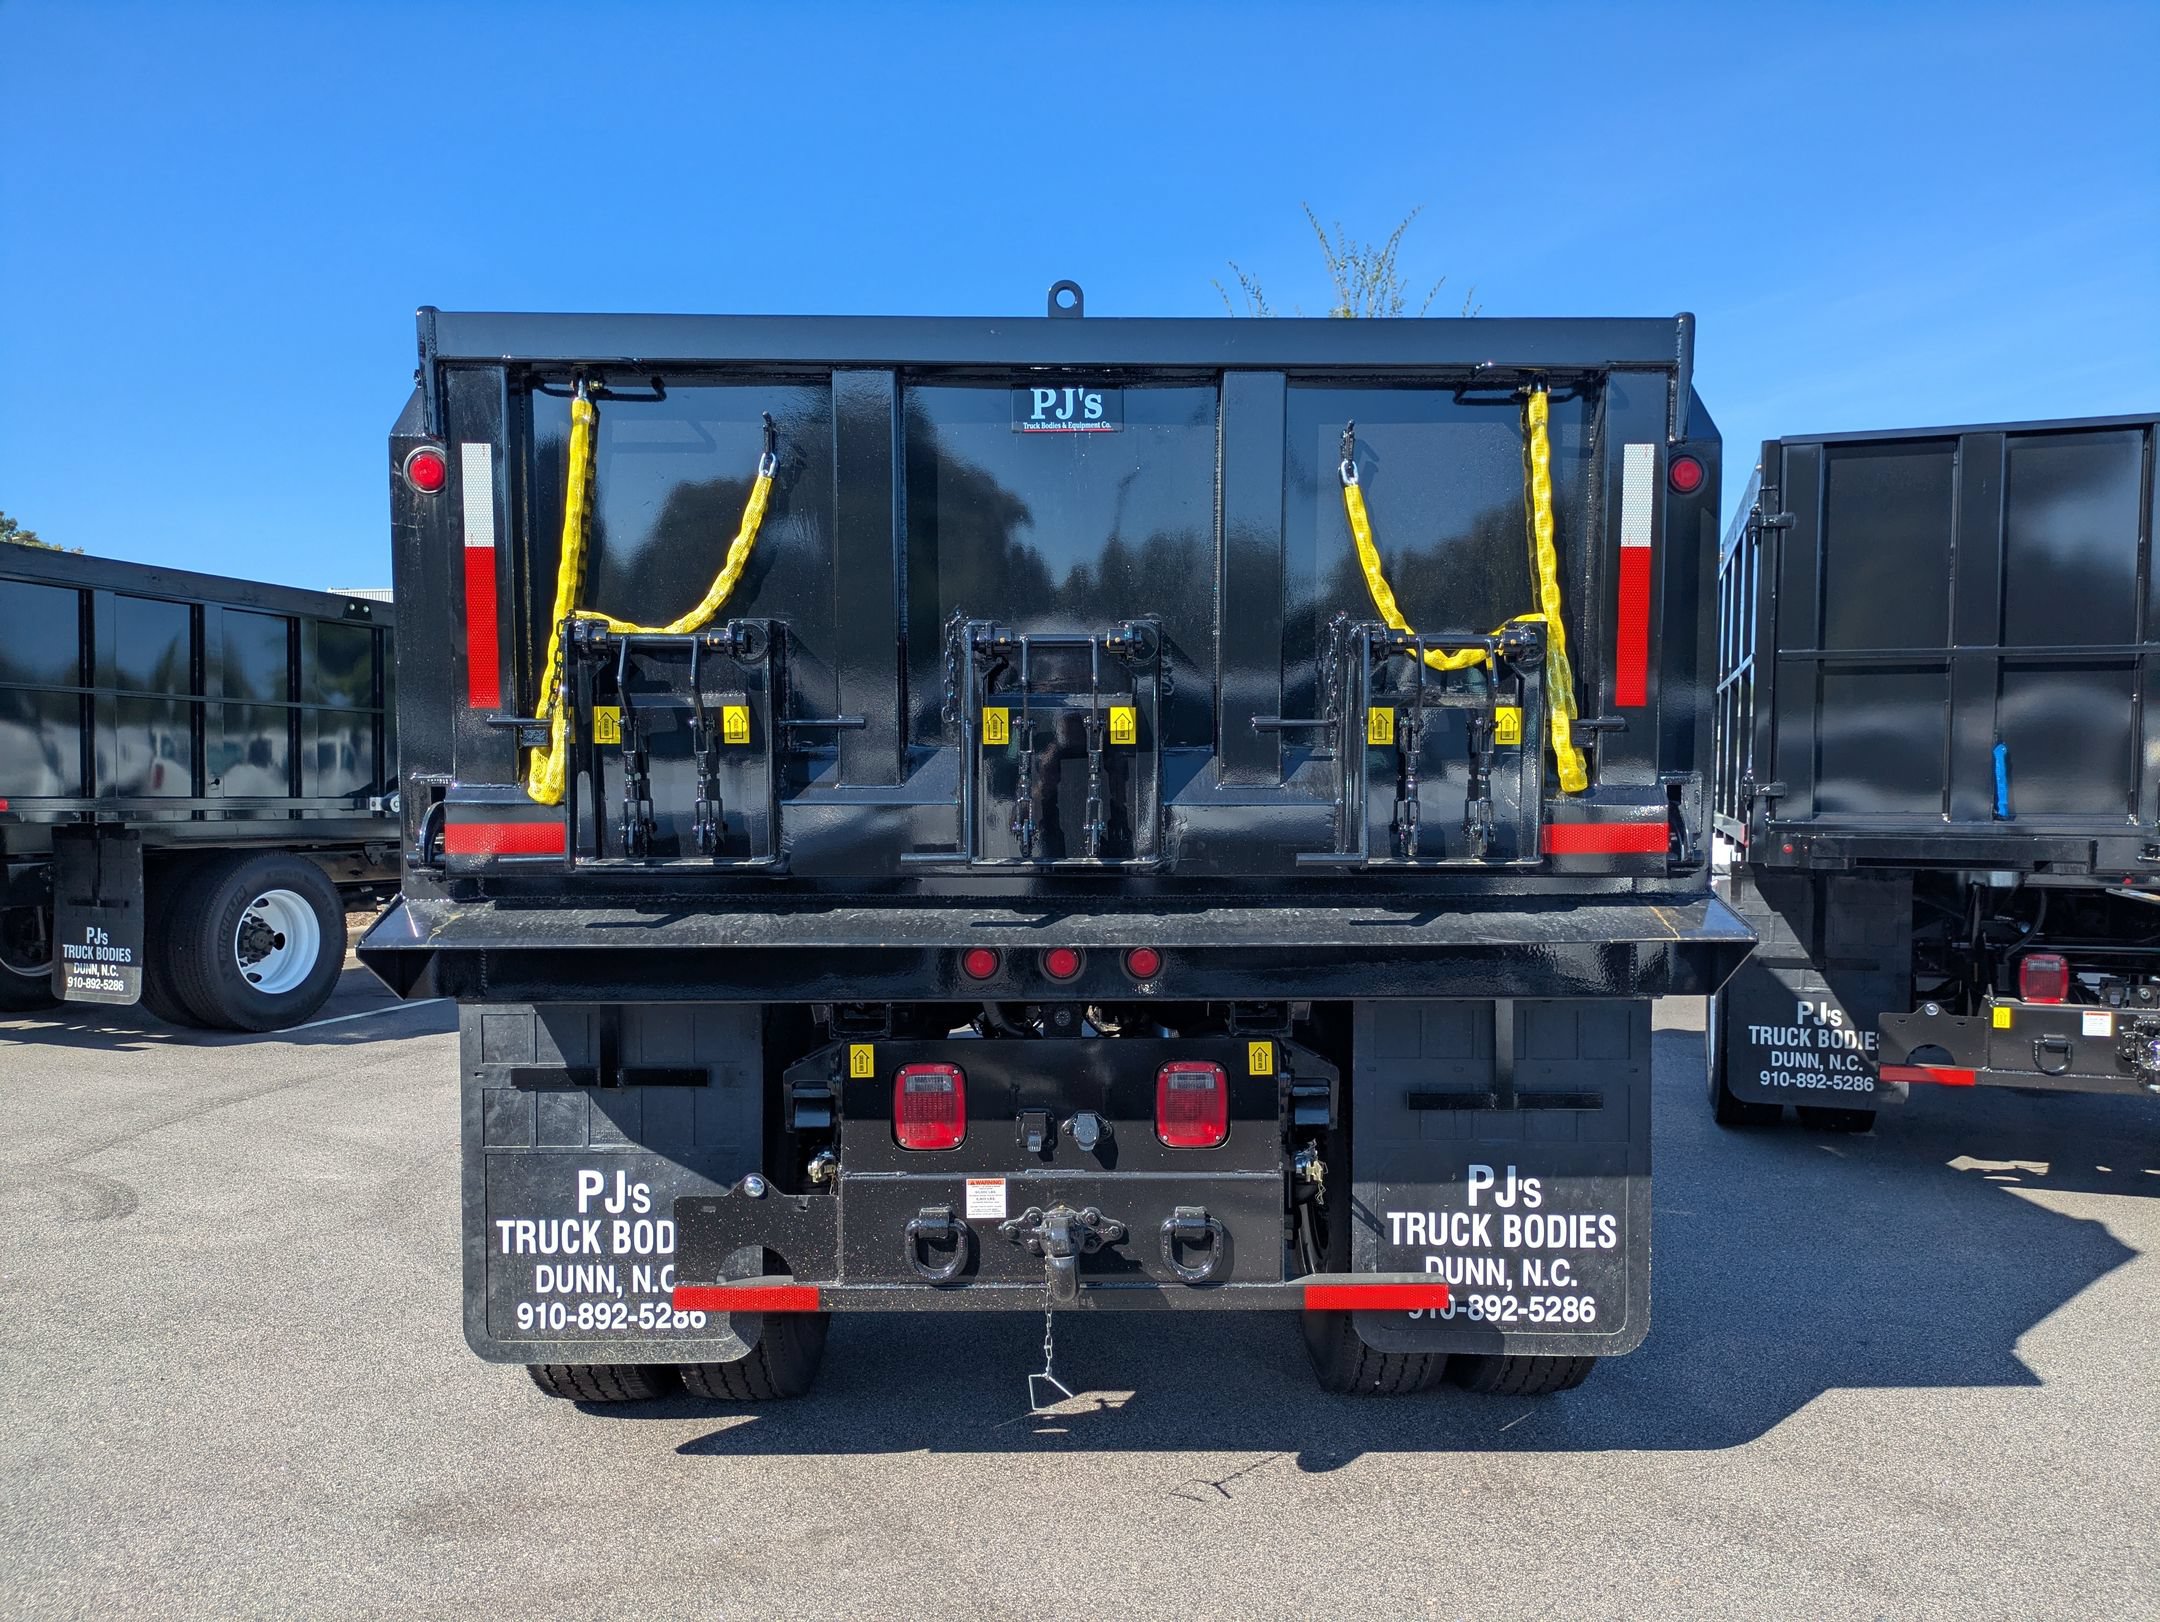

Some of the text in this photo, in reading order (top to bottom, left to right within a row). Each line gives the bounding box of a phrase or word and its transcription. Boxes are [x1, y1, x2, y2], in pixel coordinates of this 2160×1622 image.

[1030, 387, 1103, 420] PJ's
[1041, 421, 1060, 429] Bodies
[1062, 421, 1067, 429] &
[1068, 421, 1100, 431] Equipment
[86, 926, 109, 945] PJ's
[62, 944, 132, 962] TRUCK BODIES
[73, 962, 119, 977] DUNN, N.C.
[67, 976, 124, 992] 910-892-5286
[1797, 1001, 1842, 1027] PJ's
[1748, 1025, 1880, 1051] TRUCK BODIE
[1771, 1051, 1864, 1072] DUNN, N.C.
[1760, 1070, 1875, 1092] 910-892-5286
[578, 1169, 651, 1214] PJ's
[1468, 1164, 1543, 1208] PJ's
[495, 1219, 675, 1254] TRUCK BOD
[1386, 1211, 1617, 1249] TRUCK BODIES
[535, 1264, 675, 1298] DUNN, N.C
[1425, 1255, 1578, 1292] DUNN, N.C.
